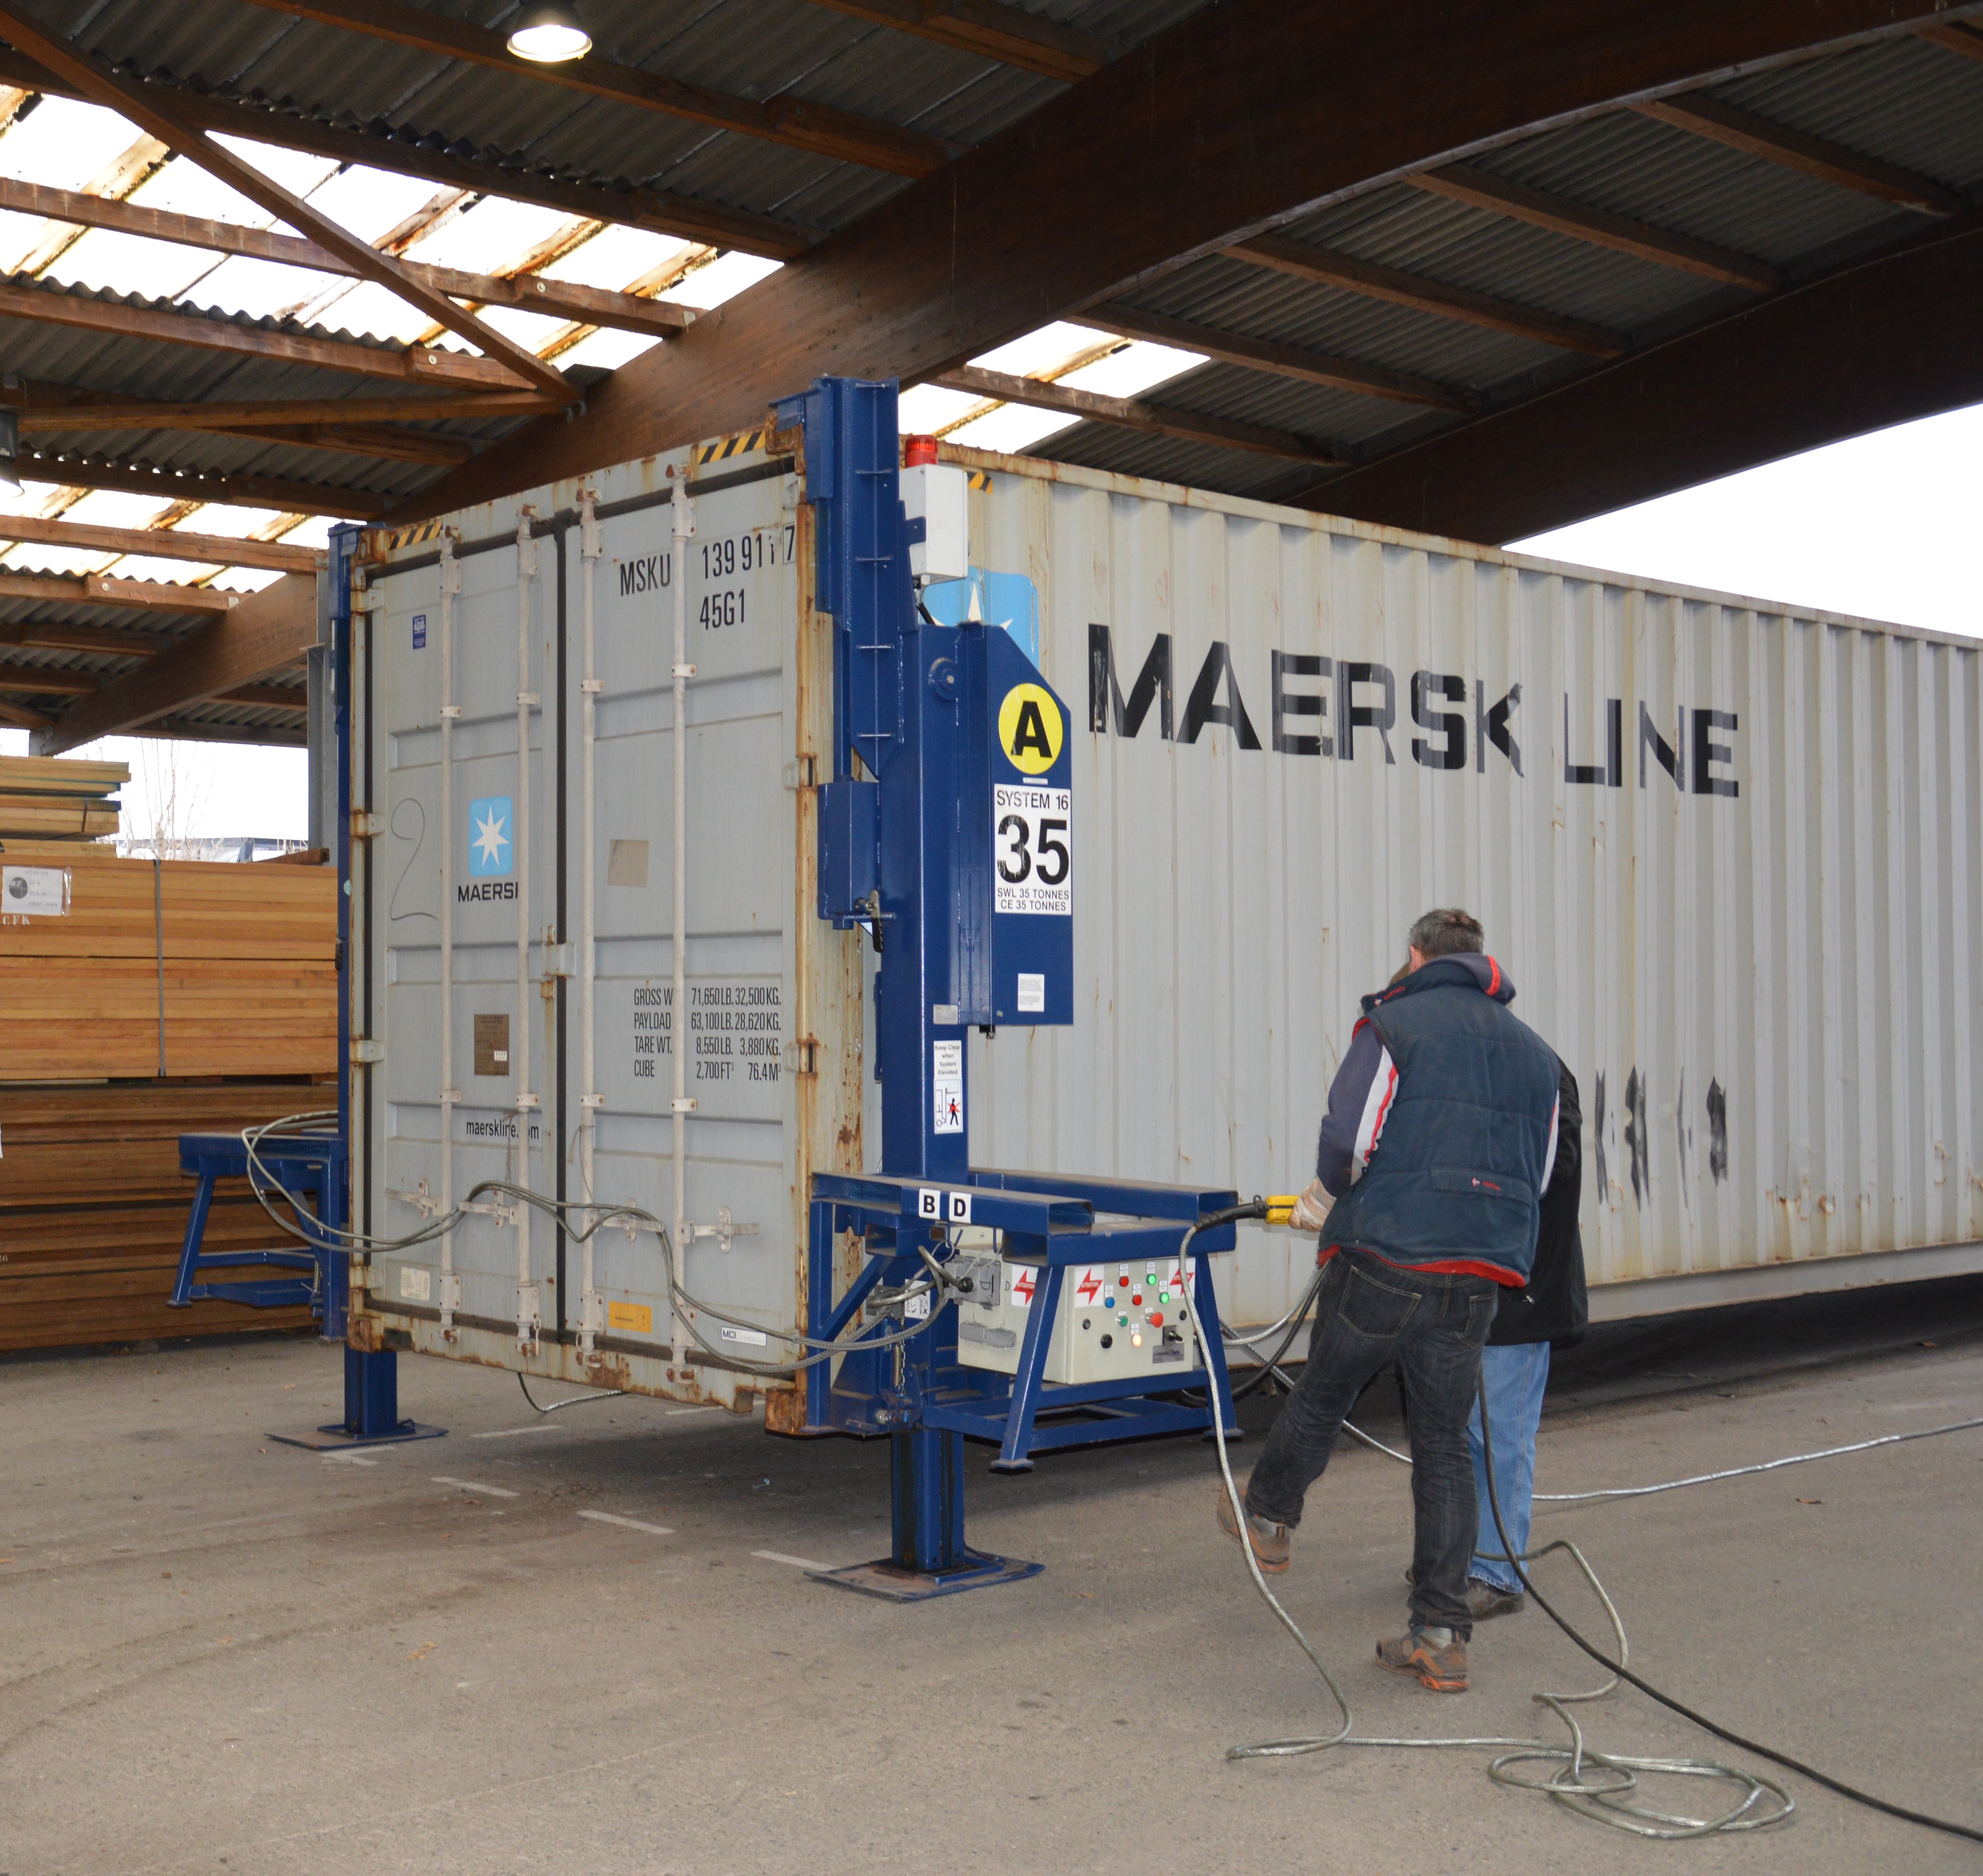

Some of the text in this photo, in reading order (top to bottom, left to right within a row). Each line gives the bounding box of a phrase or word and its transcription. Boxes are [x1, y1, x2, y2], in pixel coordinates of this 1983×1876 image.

[620, 553, 671, 596] MSKU
[702, 539, 734, 579] 139
[700, 589, 745, 629] 45G1
[1089, 623, 1739, 797] MAERSK LINE
[1010, 700, 1053, 758] A
[997, 790, 1069, 810] SYSTEM 16
[996, 814, 1070, 886] 35
[997, 887, 1069, 900] SWL 35 TONNES
[1001, 899, 1066, 911] CE 35 TONNES
[634, 987, 781, 1006] GROSS W 71,650 LB. 32,500 KG.
[634, 1012, 781, 1031] PAYLOAD 63,100 LB. 28,620 KG.
[635, 1036, 781, 1056] TARE WT. 8,550 LB. 3,880 KG.
[634, 1060, 655, 1077] CUBE
[696, 1061, 720, 1080] 2,700
[748, 1063, 768, 1081] 76.4
[466, 1119, 539, 1139] maerskline.m
[923, 1195, 935, 1214] B
[954, 1198, 966, 1217] D
[723, 1329, 736, 1339] MCI
